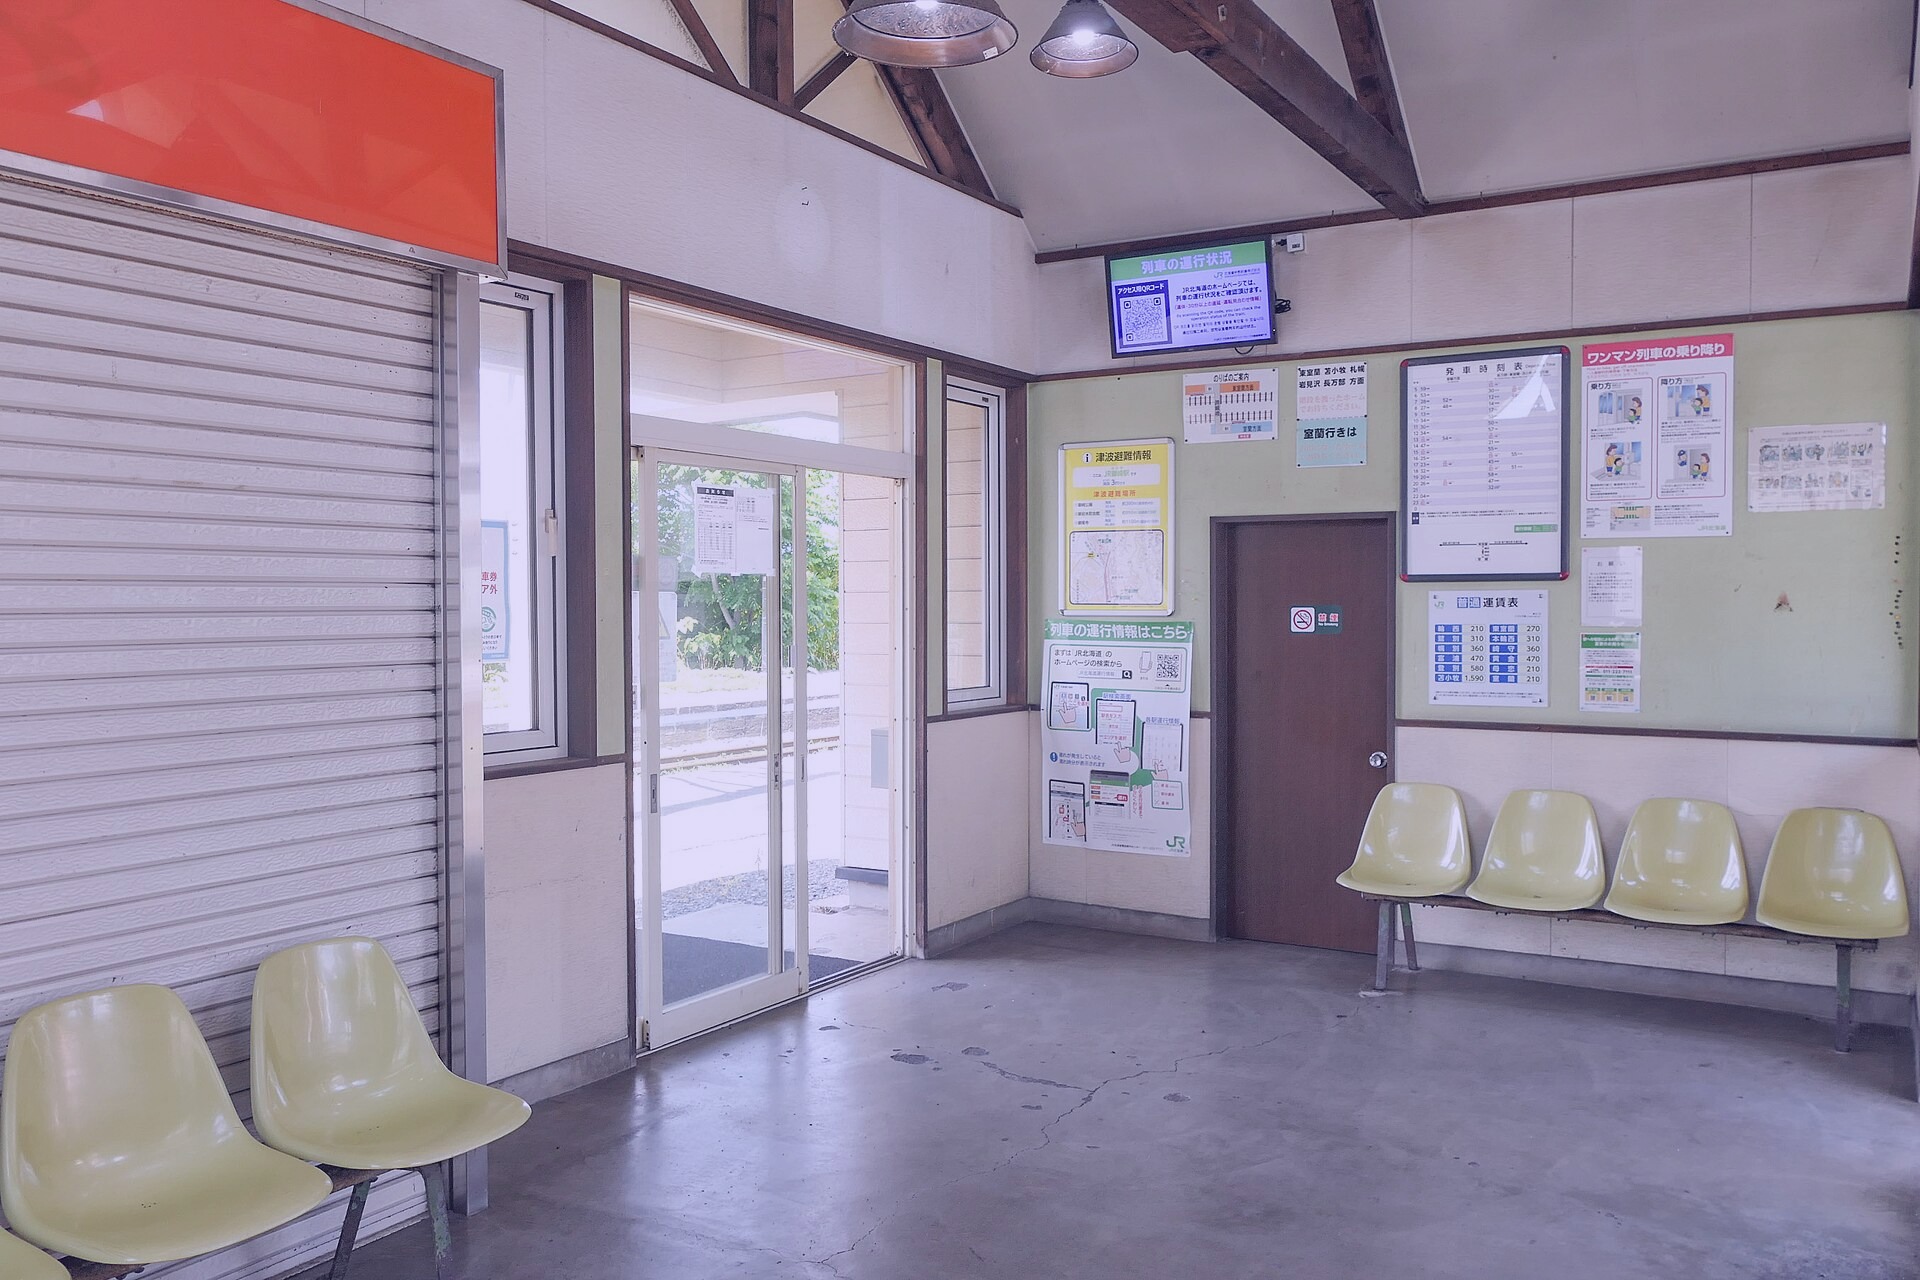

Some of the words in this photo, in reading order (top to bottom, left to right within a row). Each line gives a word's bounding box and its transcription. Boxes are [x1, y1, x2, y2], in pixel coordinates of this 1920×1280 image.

[1141, 250, 1232, 274] 列車の運行状況
[1117, 282, 1164, 295] アクセス用QRコード
[1587, 343, 1725, 364] ワンマン列車の乗り降り
[1324, 367, 1346, 375] 苫小牧
[1350, 365, 1365, 374] 札幌
[1213, 373, 1250, 382] のりばのご案内
[1299, 380, 1321, 388] 岩見沢
[1324, 378, 1346, 387] 長万部
[1350, 377, 1364, 385] 方面
[1661, 378, 1682, 386] 降り方
[1591, 382, 1611, 390] 乗り方
[1303, 427, 1357, 440] 室蘭行きは
[1095, 450, 1152, 463] 津波避難情報
[1093, 490, 1136, 498] 津波避難場所
[481, 571, 497, 581] 車券
[481, 584, 498, 594] ア外
[1050, 622, 1188, 640] 列車の運行情報はこちら
[1054, 659, 1123, 668] ホームページの検索から
[1166, 836, 1185, 848] JR
